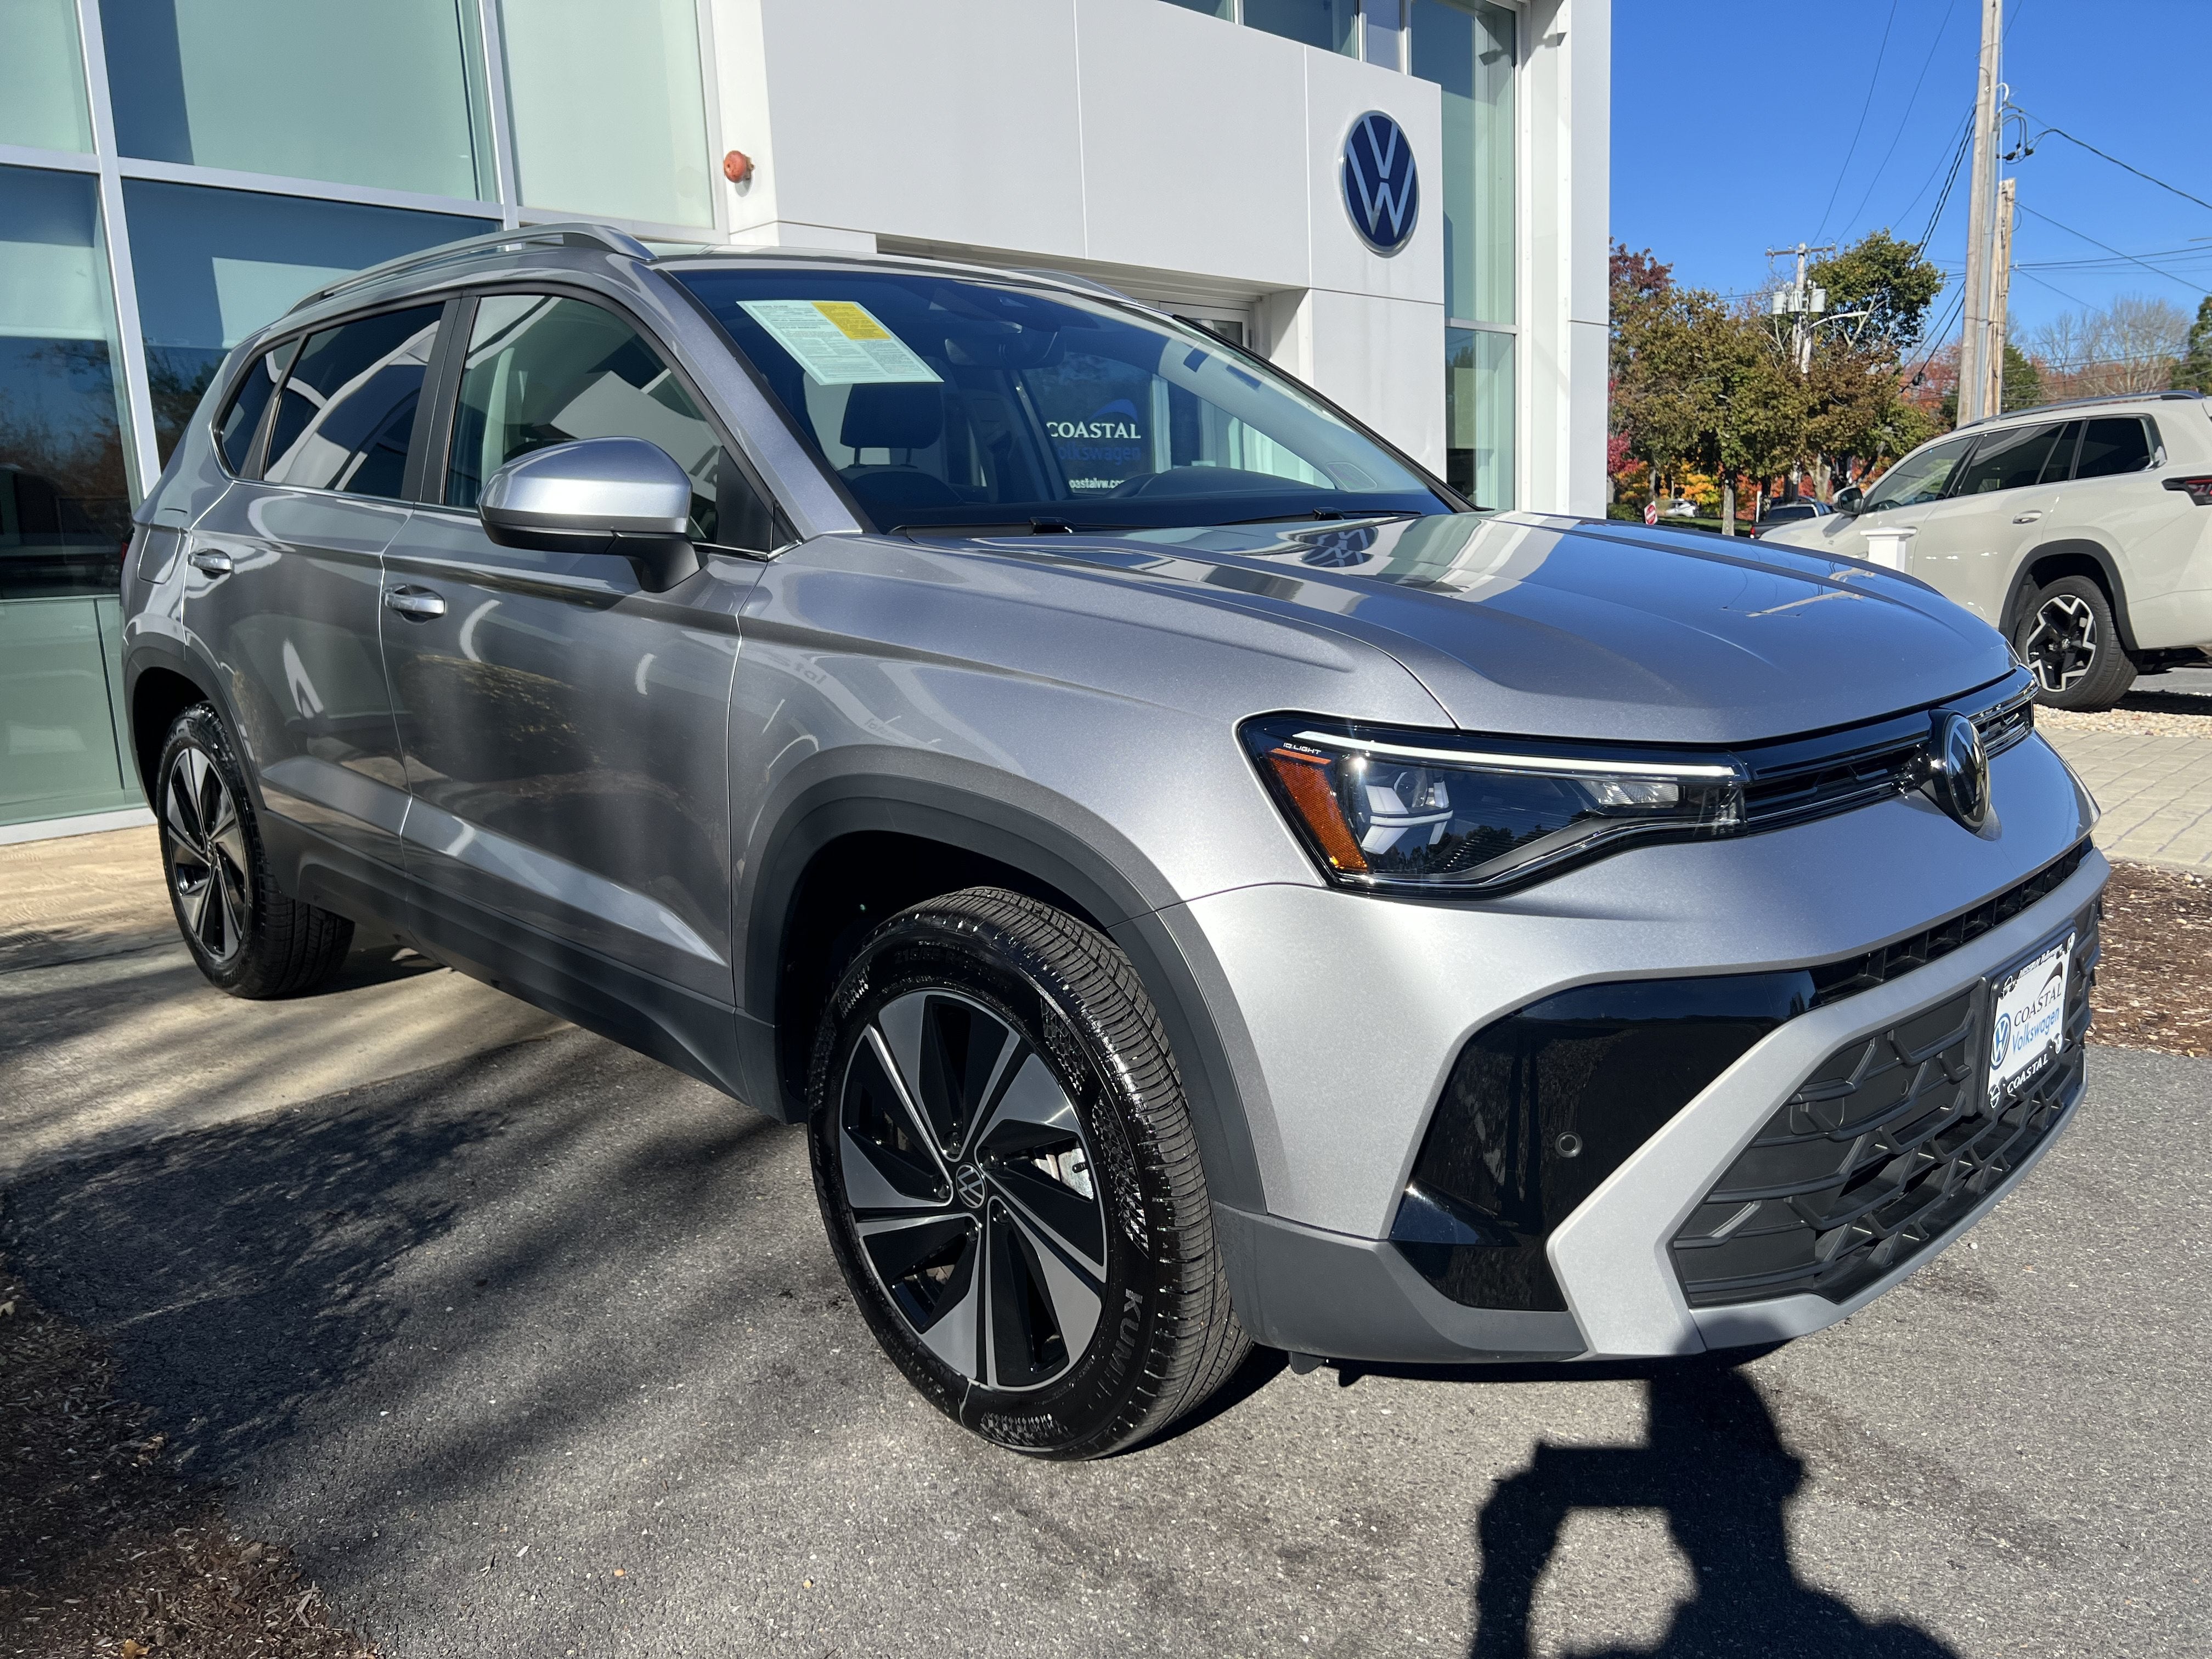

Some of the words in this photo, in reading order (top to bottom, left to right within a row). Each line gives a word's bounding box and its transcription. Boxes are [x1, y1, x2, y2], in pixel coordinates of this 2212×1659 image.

[1343, 112, 1418, 240] VW
[1055, 441, 1142, 465] olkswagen
[1283, 742, 1322, 755] IQ.LIGHT
[2014, 981, 2062, 1027] COASTAL
[2012, 1007, 2059, 1054] Volkswagen
[2007, 1053, 2049, 1094] COASTAL
